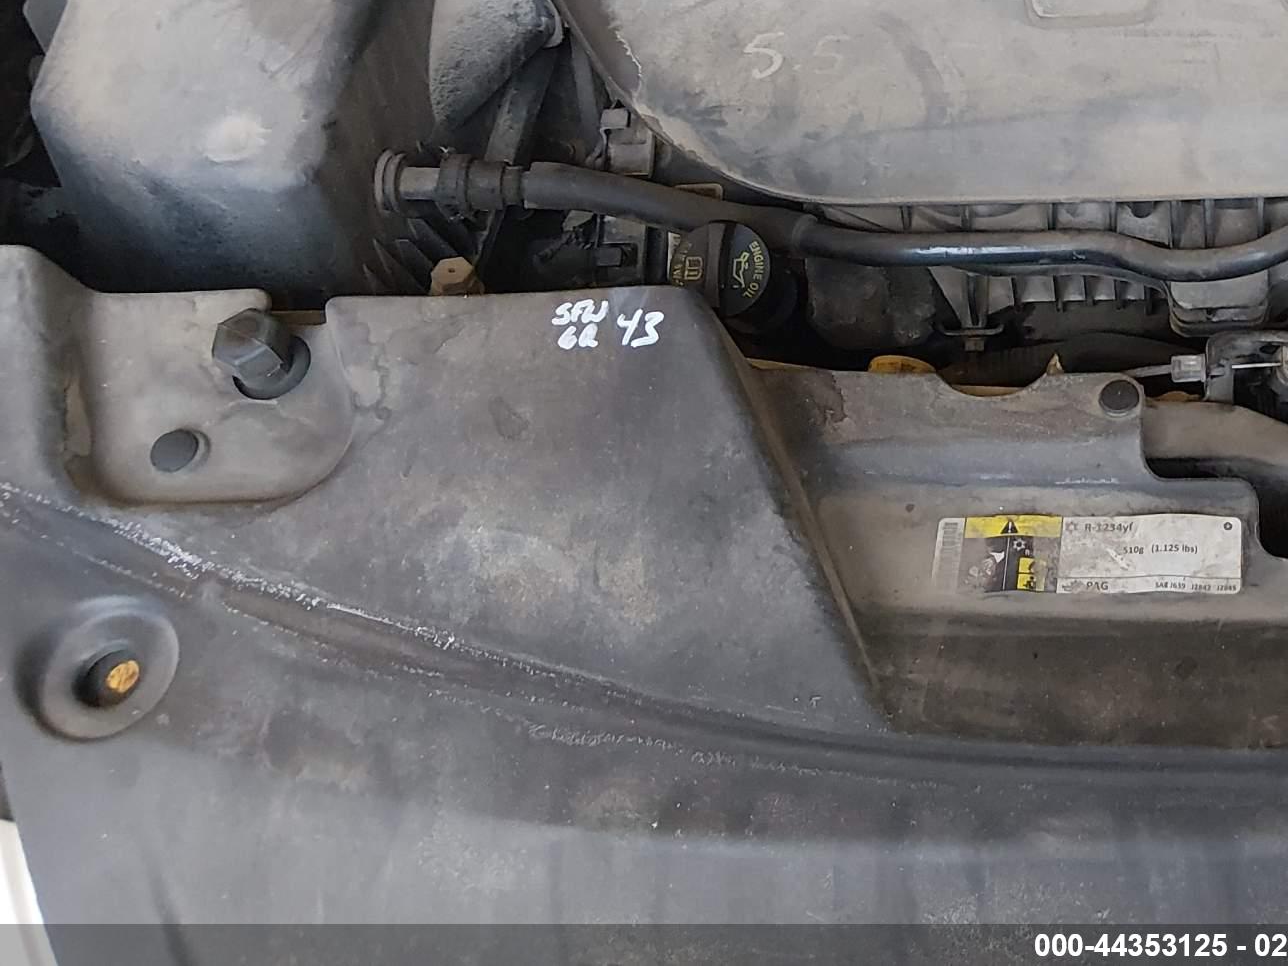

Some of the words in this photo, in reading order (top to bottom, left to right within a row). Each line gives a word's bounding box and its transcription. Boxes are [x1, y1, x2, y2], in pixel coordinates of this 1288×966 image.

[748, 240, 764, 281] ENGINE
[743, 281, 760, 298] OIL
[616, 308, 665, 349] 43
[1084, 521, 1134, 533] R-1234yf
[1123, 545, 1144, 555] 510g
[1151, 544, 1180, 553] (1.125
[1182, 545, 1198, 555] lbs)
